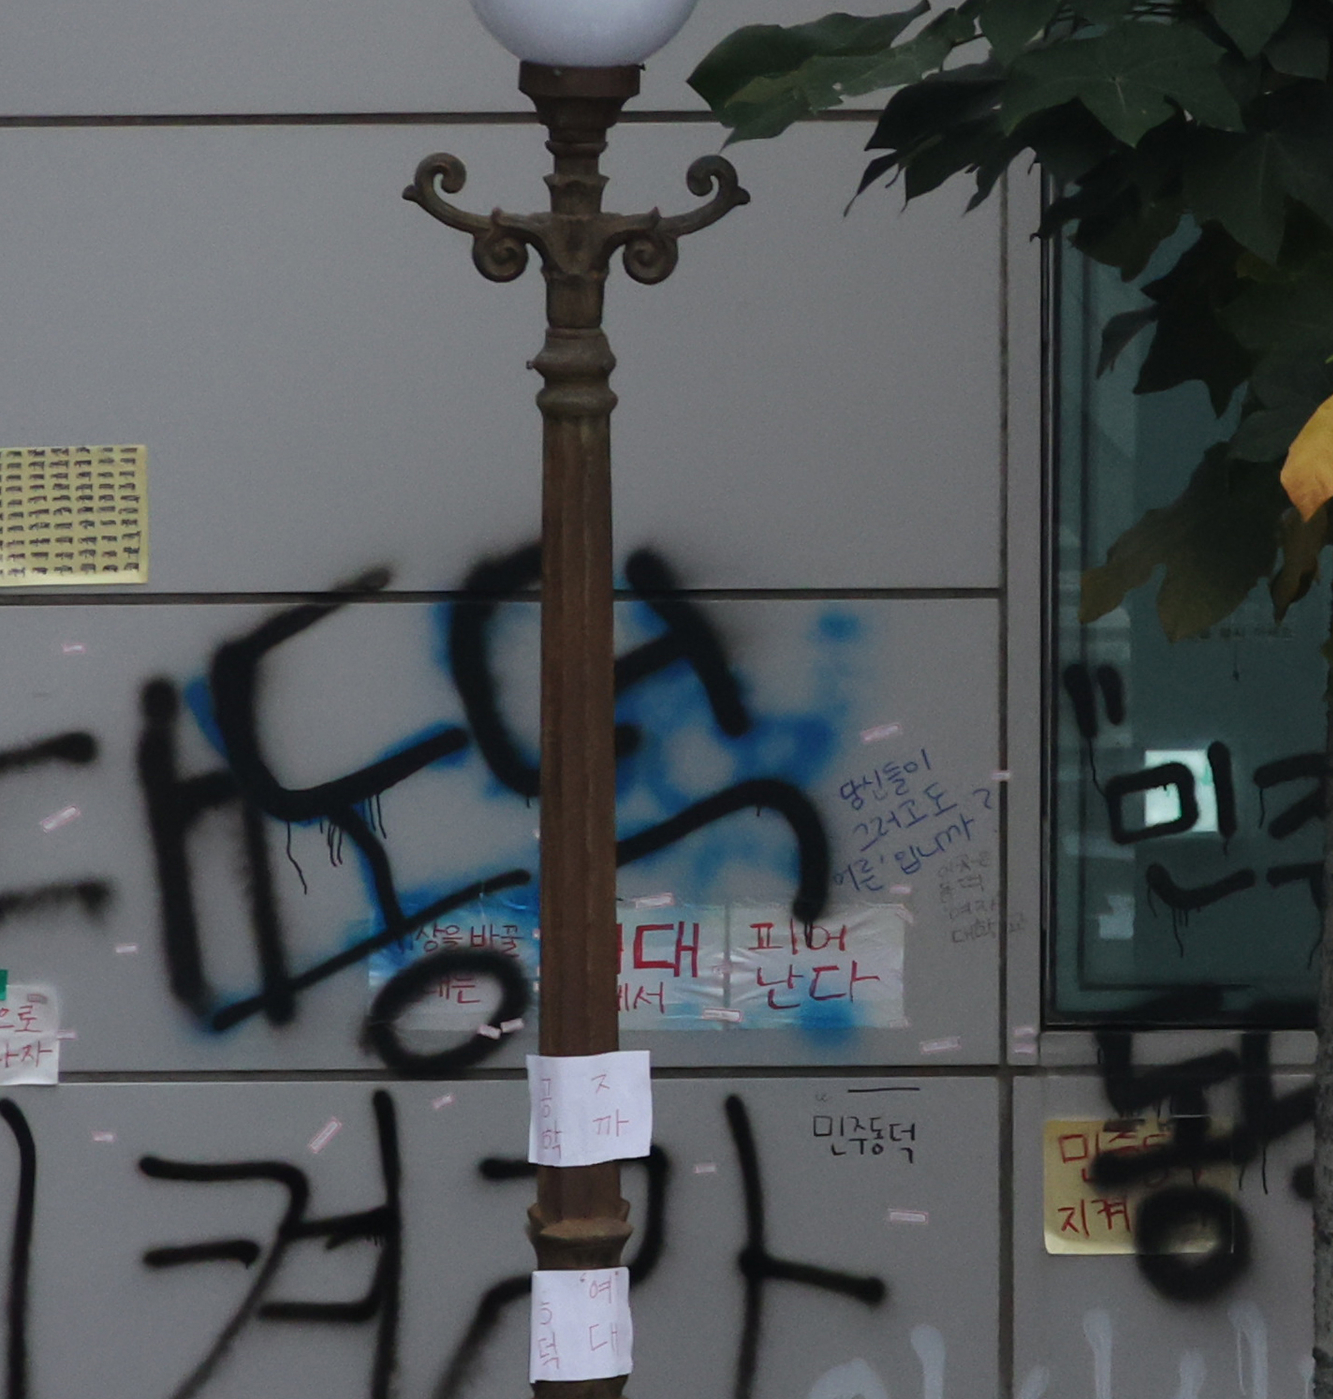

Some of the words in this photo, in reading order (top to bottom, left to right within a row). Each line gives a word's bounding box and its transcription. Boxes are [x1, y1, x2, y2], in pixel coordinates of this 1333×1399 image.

[838, 748, 933, 812] 당신들이
[398, 921, 463, 953] 상을
[616, 920, 700, 978] 대
[748, 918, 848, 956] 피어
[756, 960, 881, 1012] 난다
[812, 1114, 917, 1165] 민주동덕
